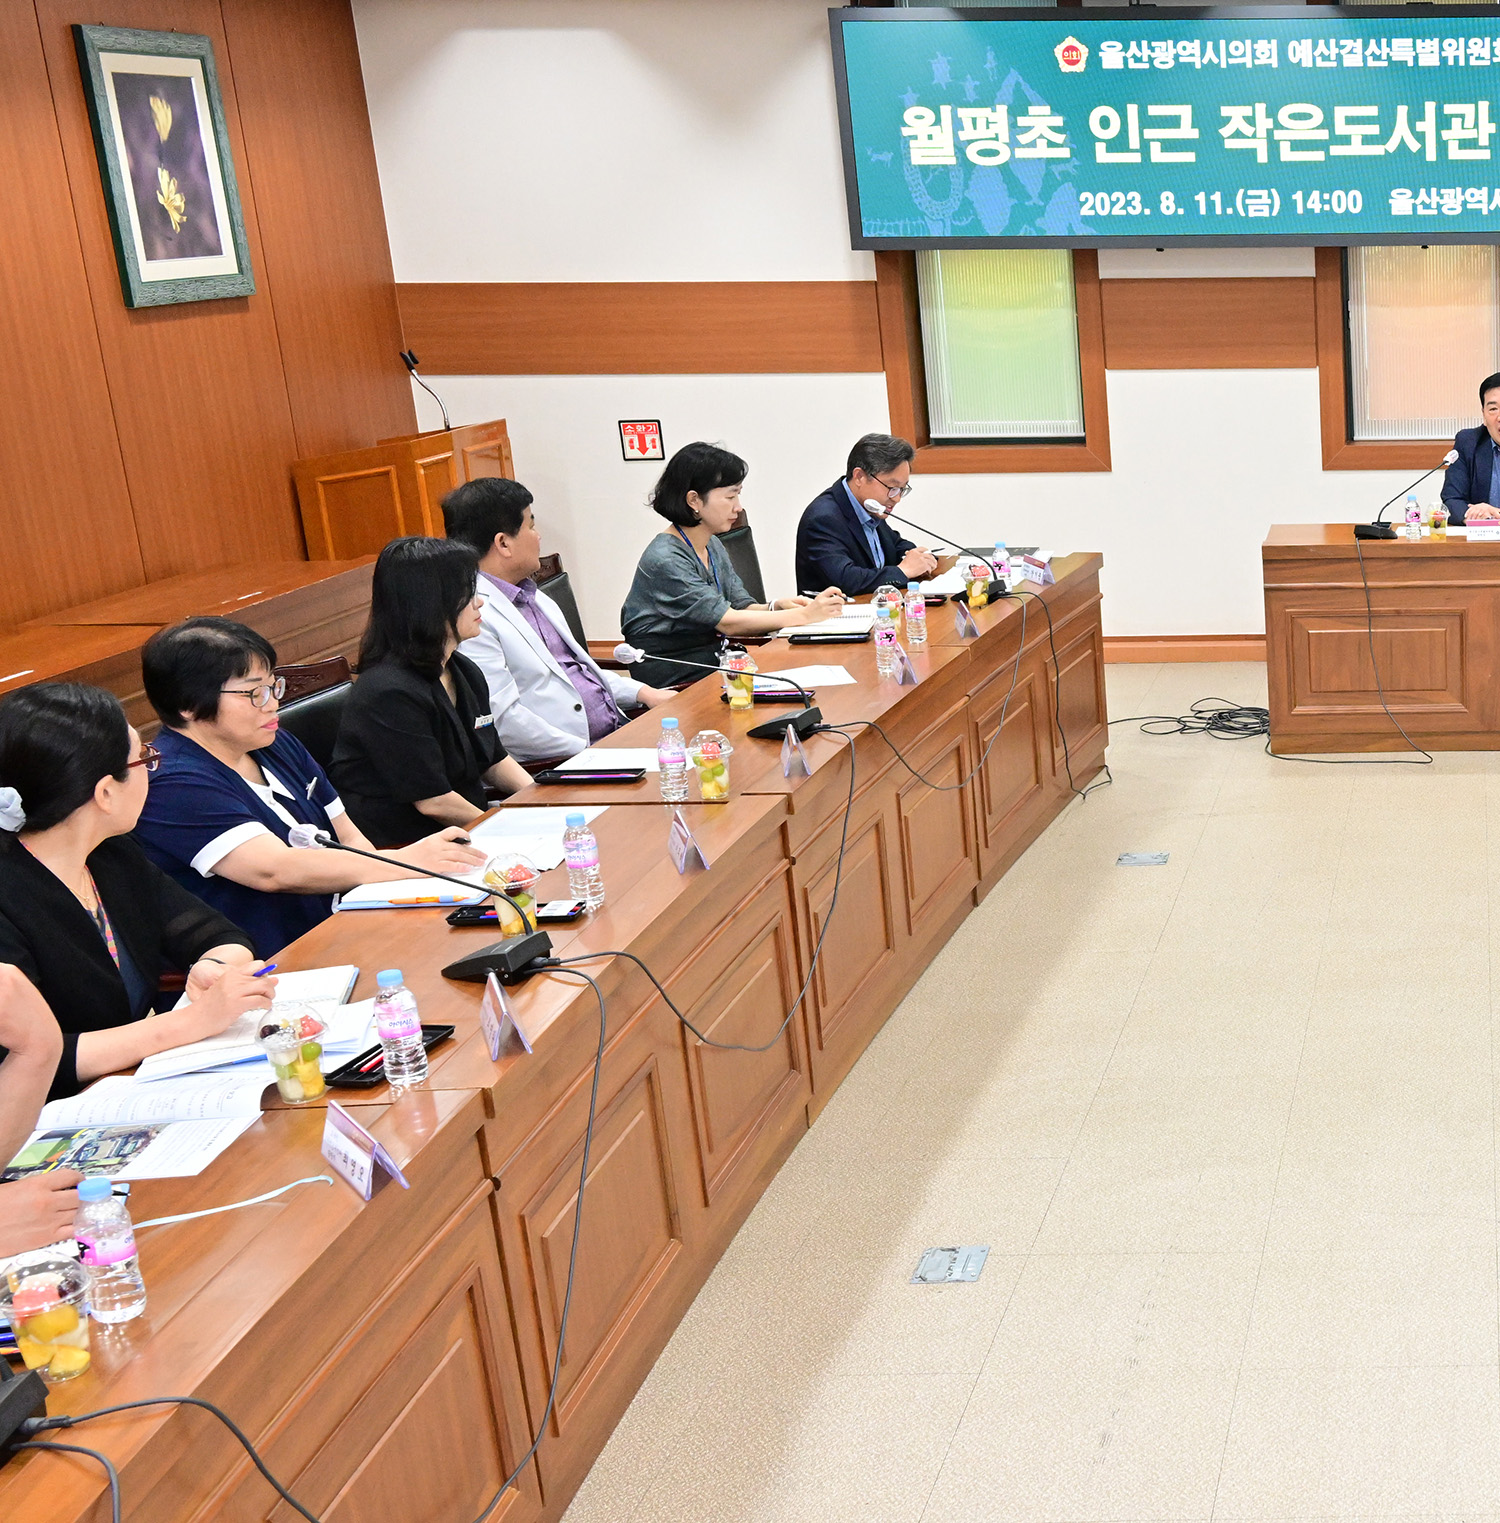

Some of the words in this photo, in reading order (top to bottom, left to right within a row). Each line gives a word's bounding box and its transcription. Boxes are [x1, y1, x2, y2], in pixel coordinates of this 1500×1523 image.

[1063, 50, 1080, 60] 의회
[1099, 39, 1279, 69] 울산광역시의회
[901, 105, 1071, 166] 월평초
[1089, 104, 1200, 163] 인근
[1218, 102, 1496, 163] 작은도서관
[1079, 191, 1150, 216] 2023.
[1160, 191, 1184, 216] 8.
[1194, 188, 1281, 217] 11.(금)
[1291, 190, 1363, 215] 14:00
